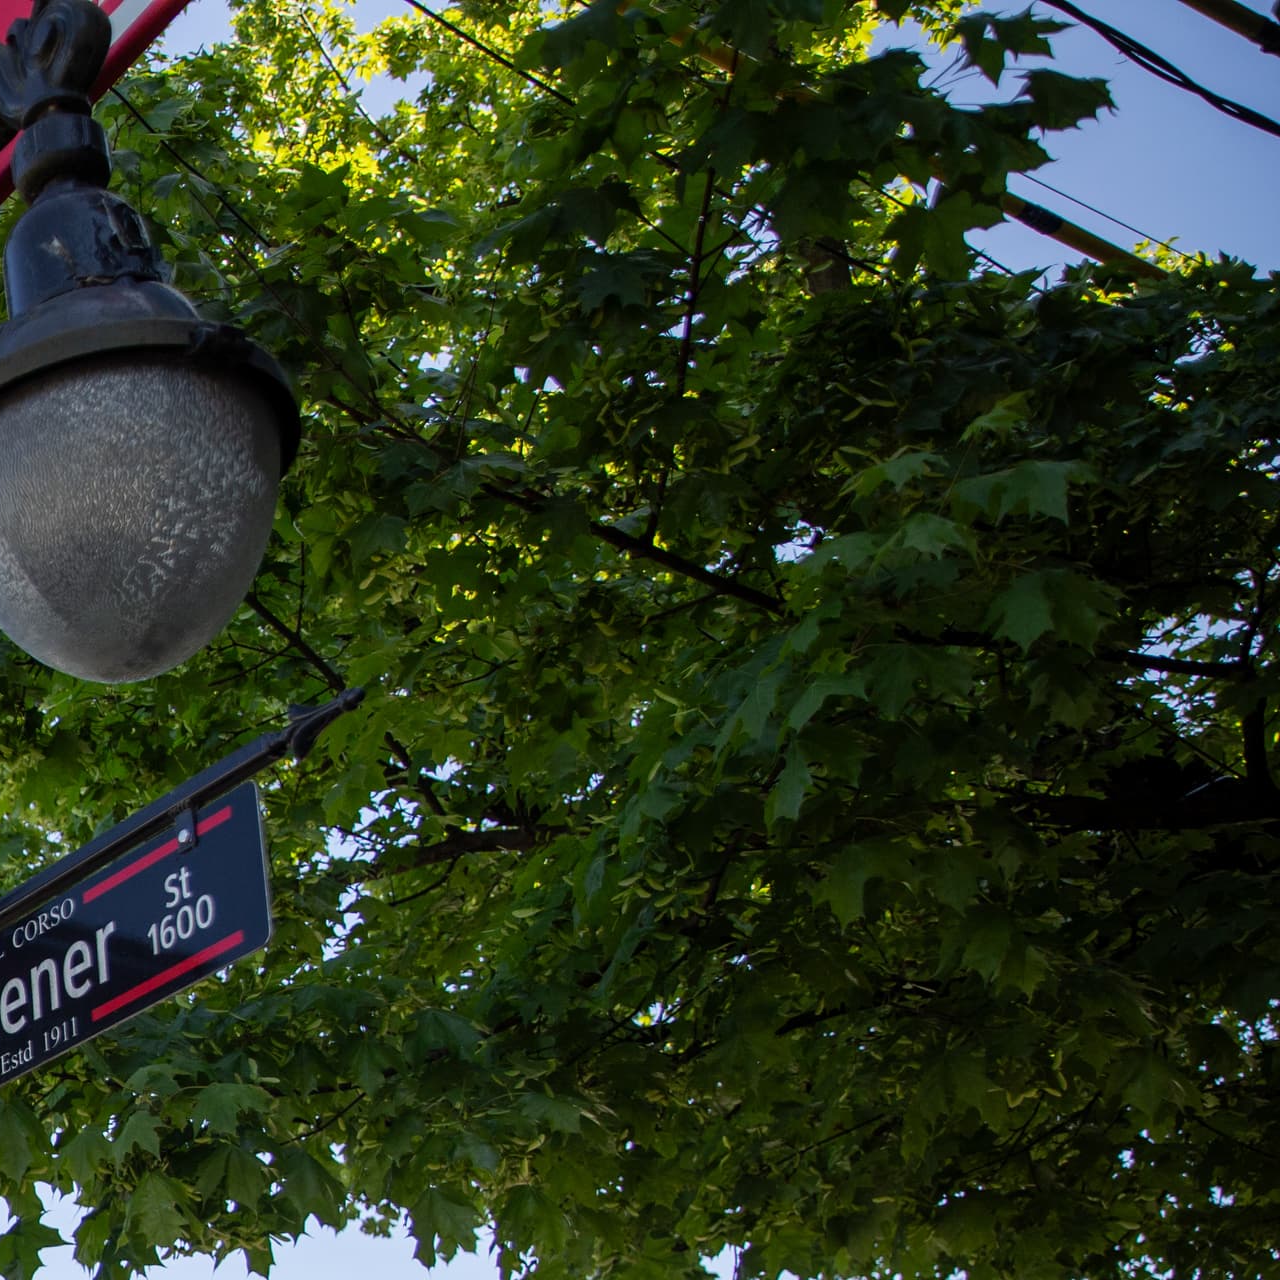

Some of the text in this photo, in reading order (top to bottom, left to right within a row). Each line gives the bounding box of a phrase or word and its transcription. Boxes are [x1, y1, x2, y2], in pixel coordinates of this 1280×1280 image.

[163, 865, 193, 910] St
[11, 897, 76, 951] CORSO
[146, 893, 216, 957] 1600
[0, 1015, 79, 1076] Estd 1911
